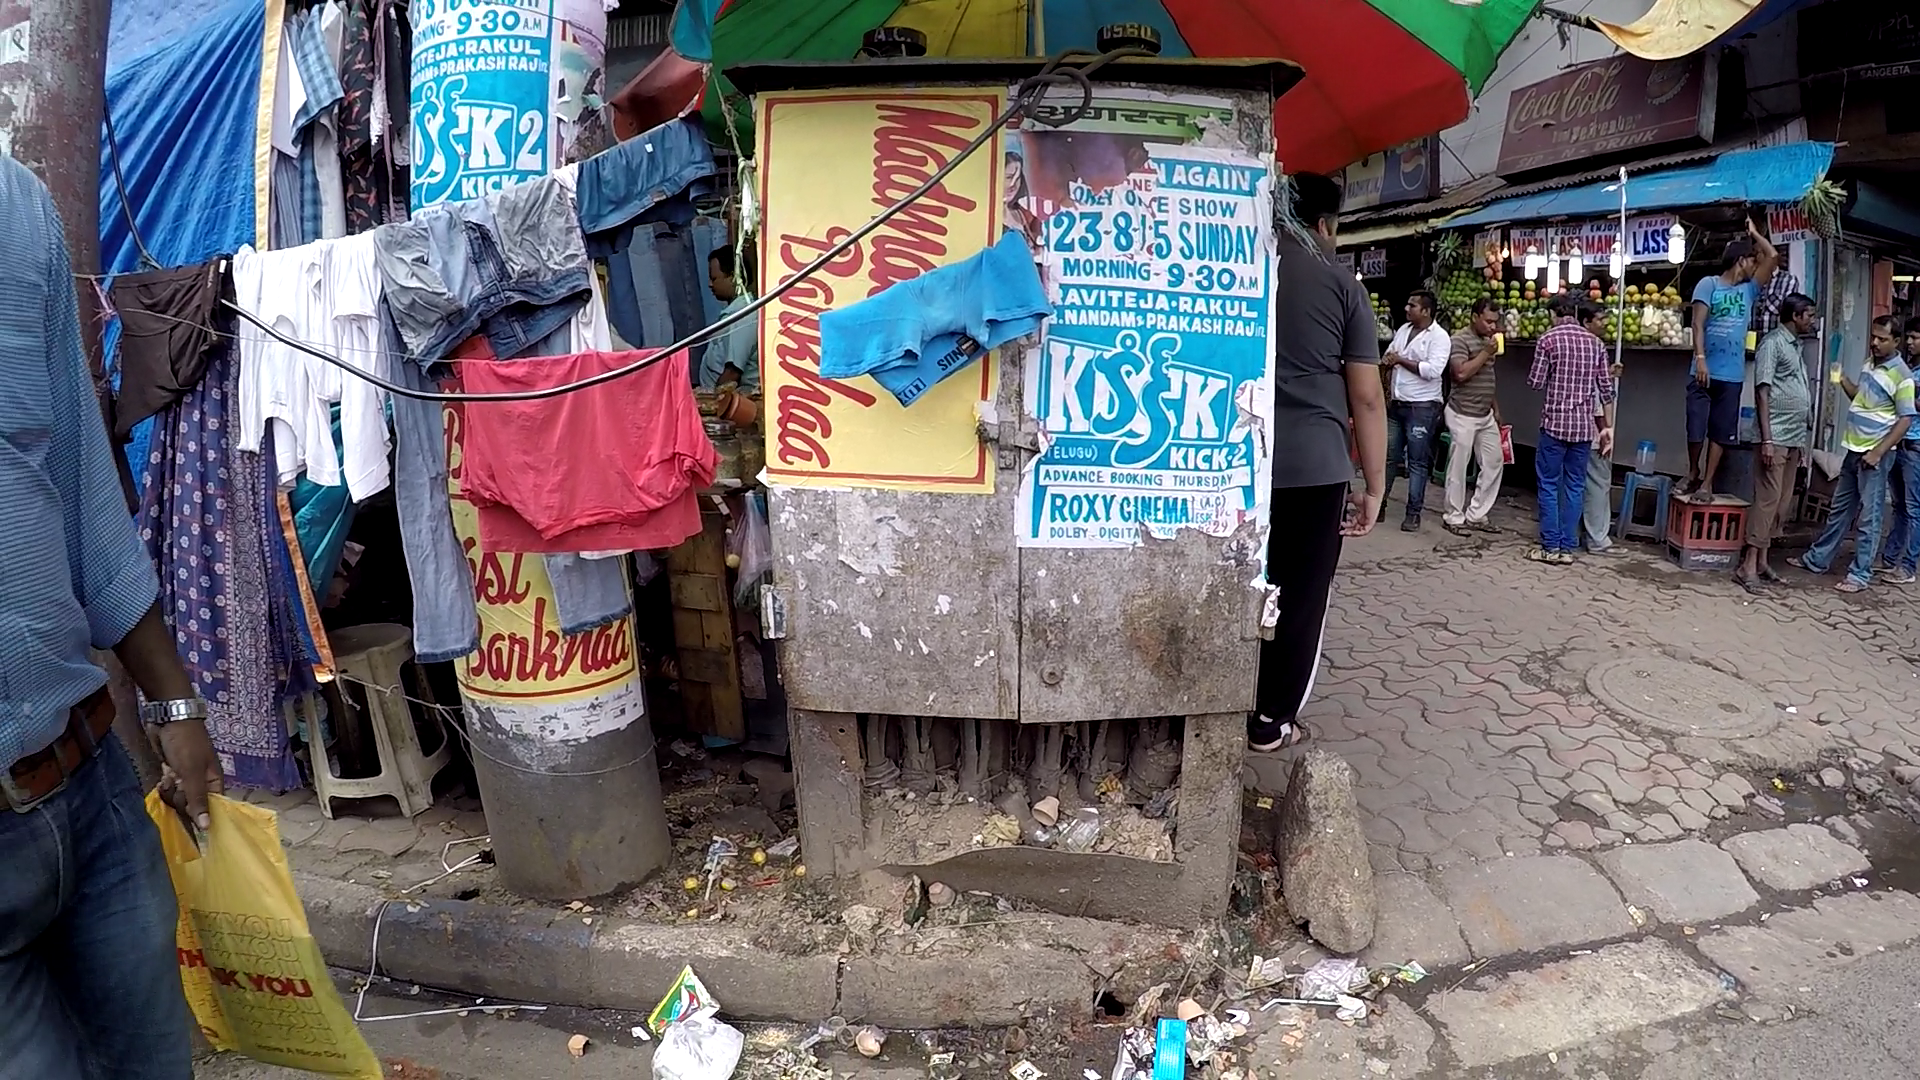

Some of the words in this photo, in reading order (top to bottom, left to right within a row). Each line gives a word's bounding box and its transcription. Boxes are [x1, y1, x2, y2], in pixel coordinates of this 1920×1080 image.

[440, 55, 506, 76] PRAKASH
[1594, 128, 1659, 151] DRINK
[1172, 164, 1251, 191] AGAIN
[1178, 198, 1238, 218] SHOW
[1554, 226, 1583, 236] ENJOY
[1590, 223, 1618, 233] ENJOY
[1638, 218, 1670, 229] ENJOY
[1769, 209, 1814, 234] MANG
[1179, 222, 1258, 264] SUNDAY
[1632, 228, 1670, 256] LASS
[1781, 232, 1807, 243] JUICE
[1146, 311, 1222, 334] PRAKASH
[1224, 318, 1254, 336] RAJ
[1043, 469, 1105, 484] ADVANCE
[1110, 471, 1163, 486] BOOKING
[1173, 474, 1233, 488] THURSDAY
[1050, 493, 1117, 523] ROXY
[1119, 494, 1190, 525] CINEMA
[1050, 527, 1089, 538] DOLBY
[1099, 526, 1141, 540] DIGITA
